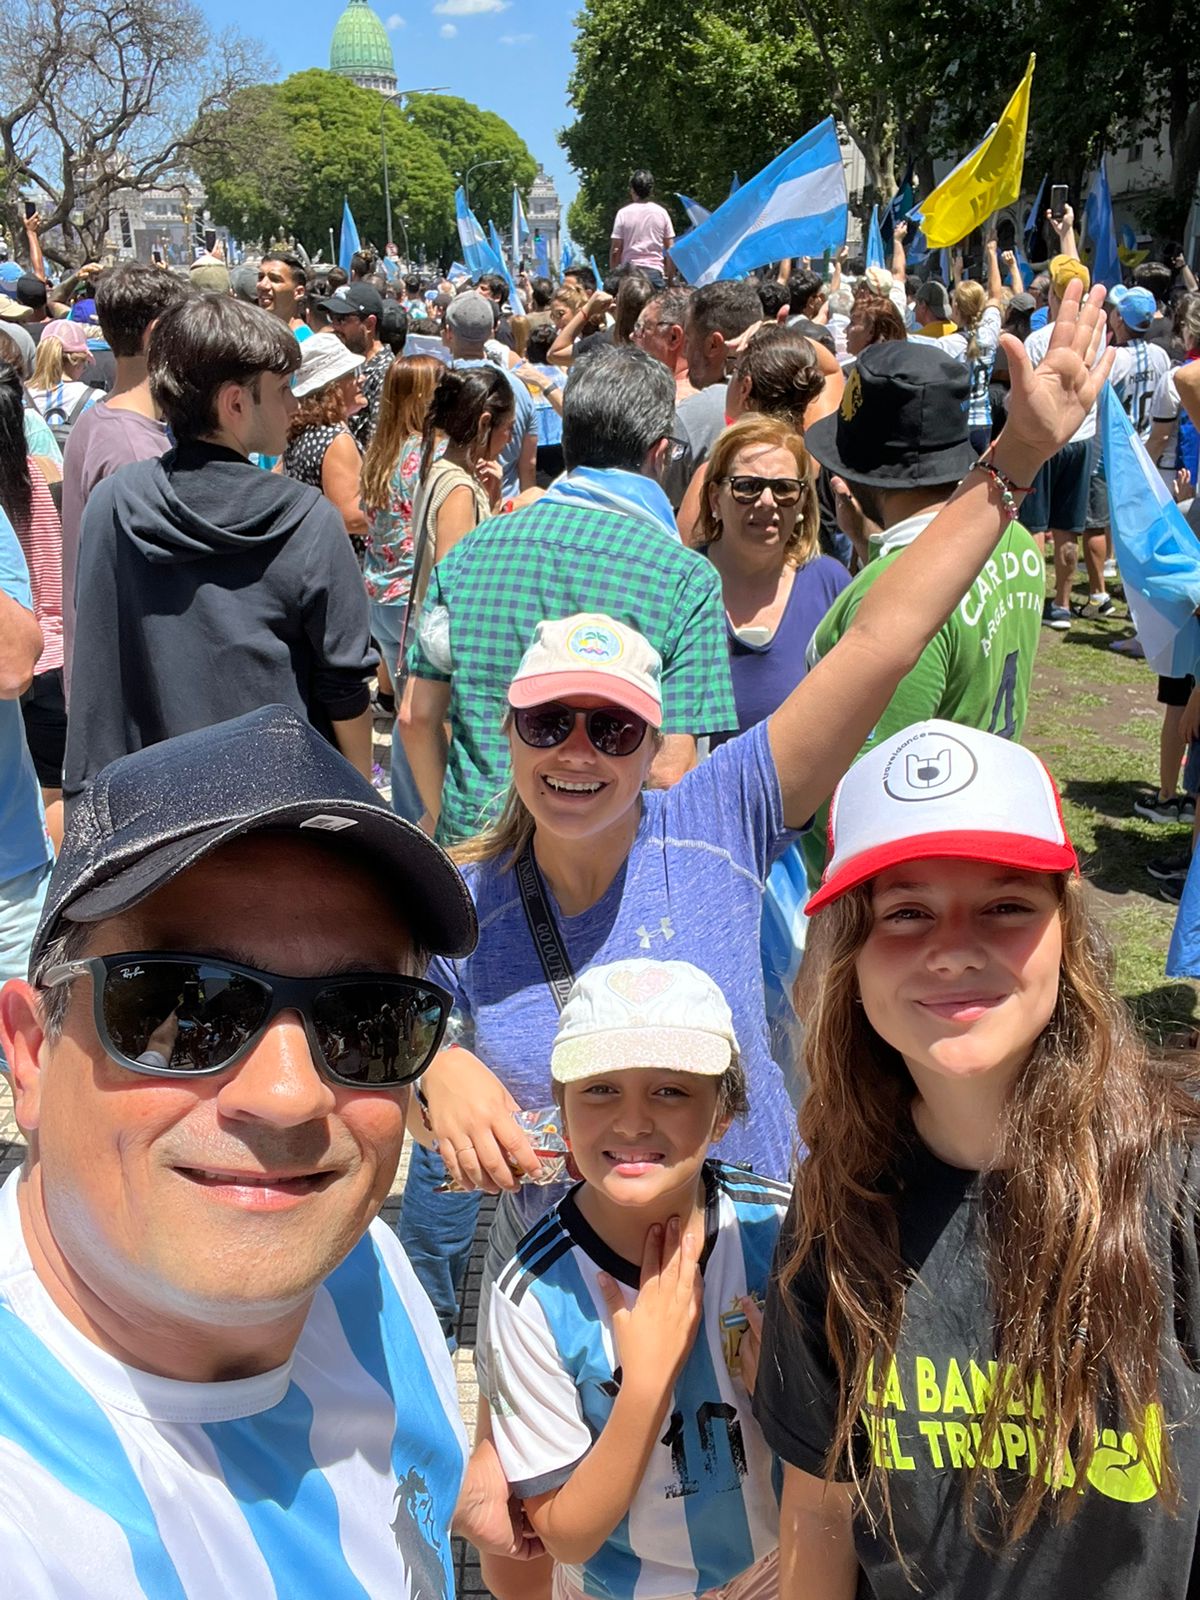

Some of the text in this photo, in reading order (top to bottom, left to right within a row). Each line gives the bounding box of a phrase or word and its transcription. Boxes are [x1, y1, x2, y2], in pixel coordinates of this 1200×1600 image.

[960, 549, 1046, 627] CARDO
[882, 732, 927, 780] traveldance
[536, 922, 553, 942] GO
[867, 1354, 906, 1412] LA
[661, 1401, 749, 1499] 10
[860, 1408, 917, 1470] EL
